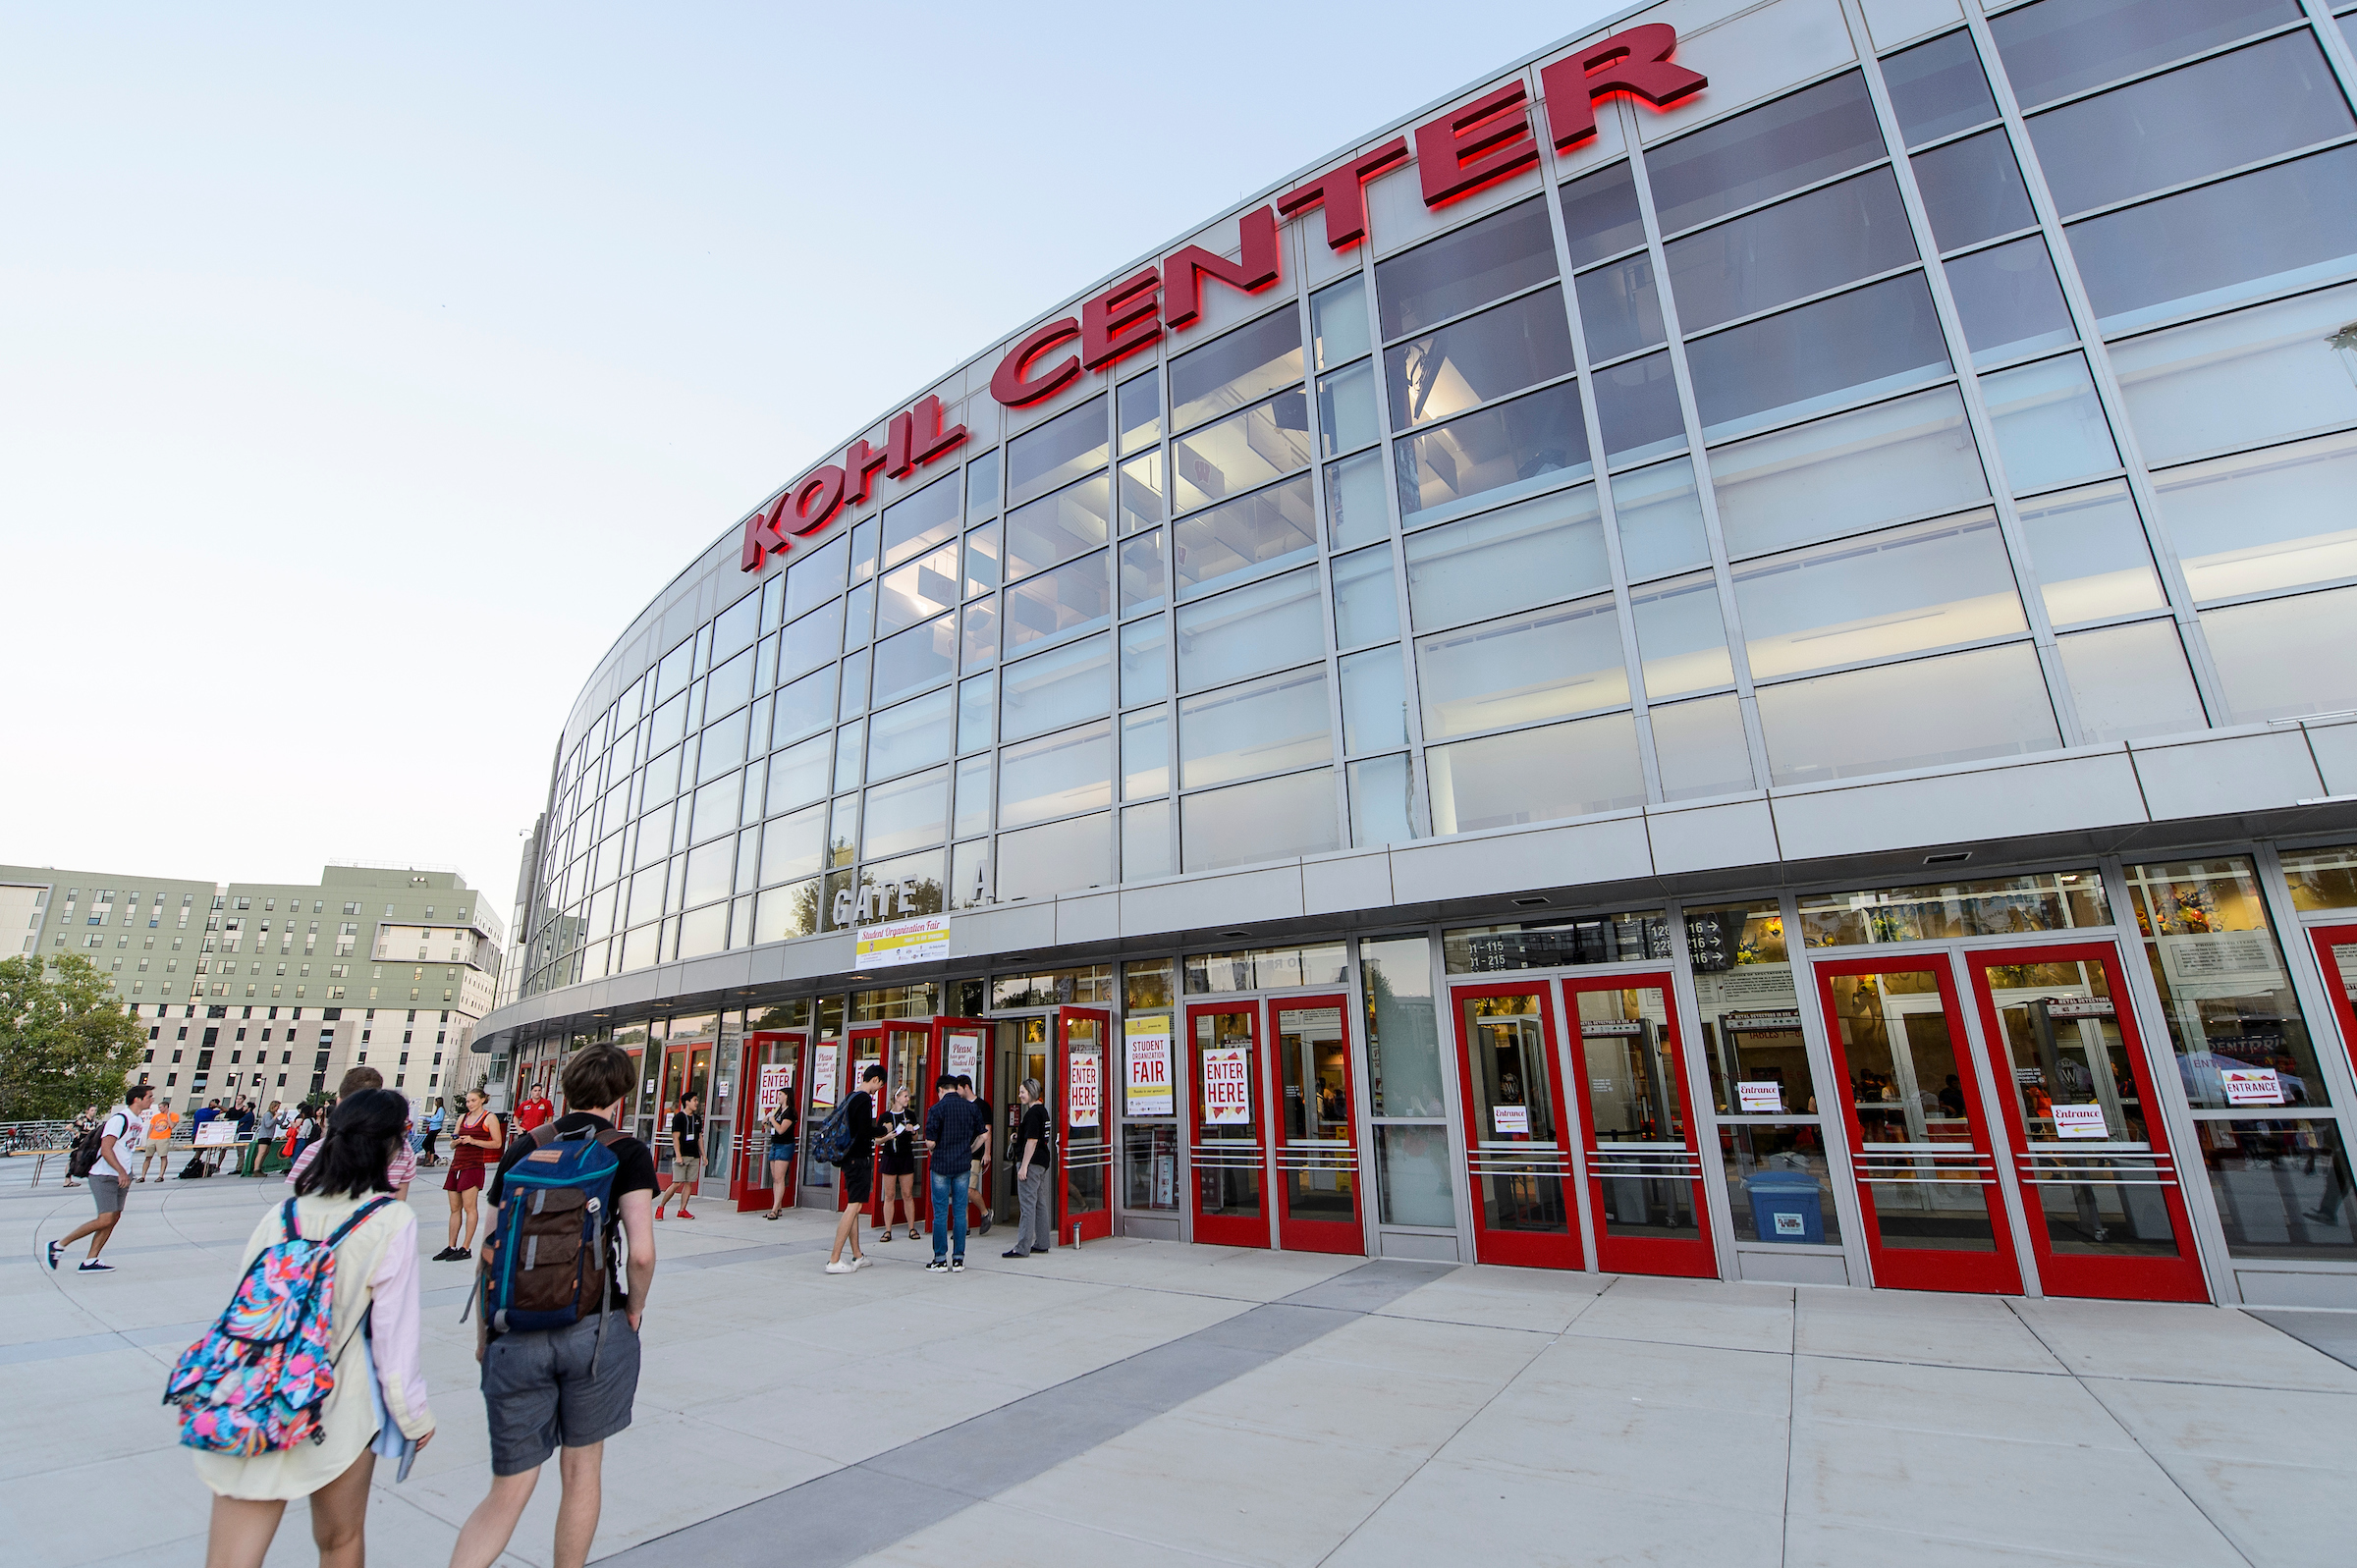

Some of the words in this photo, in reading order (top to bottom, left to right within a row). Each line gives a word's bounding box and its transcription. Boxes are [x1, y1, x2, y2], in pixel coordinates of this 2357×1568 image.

[740, 394, 967, 572] KOHL
[990, 23, 1708, 406] CENTER
[833, 874, 918, 925] GATE
[970, 859, 996, 901] A
[861, 930, 885, 941] Student
[885, 923, 925, 939] Organization
[925, 920, 941, 931] Fair
[1486, 941, 1505, 952] 115
[1487, 954, 1506, 966] 215
[953, 1043, 972, 1054] Please
[1132, 1040, 1164, 1052] STUDENT
[818, 1053, 834, 1061] Please
[967, 1056, 976, 1066] ID
[1132, 1052, 1165, 1060] ORGANIZATION
[1071, 1067, 1096, 1084] ENTER
[1133, 1060, 1165, 1083] FAIR
[1207, 1062, 1244, 1080] ENTER
[762, 1074, 790, 1088] ENTER
[1208, 1082, 1245, 1103] HERE
[1740, 1085, 1777, 1094] Entrance
[2226, 1082, 2277, 1093] ENTRANCE
[1071, 1086, 1097, 1107] HERE
[1496, 1108, 1524, 1117] Entrance
[2056, 1109, 2101, 1118] Entrance
